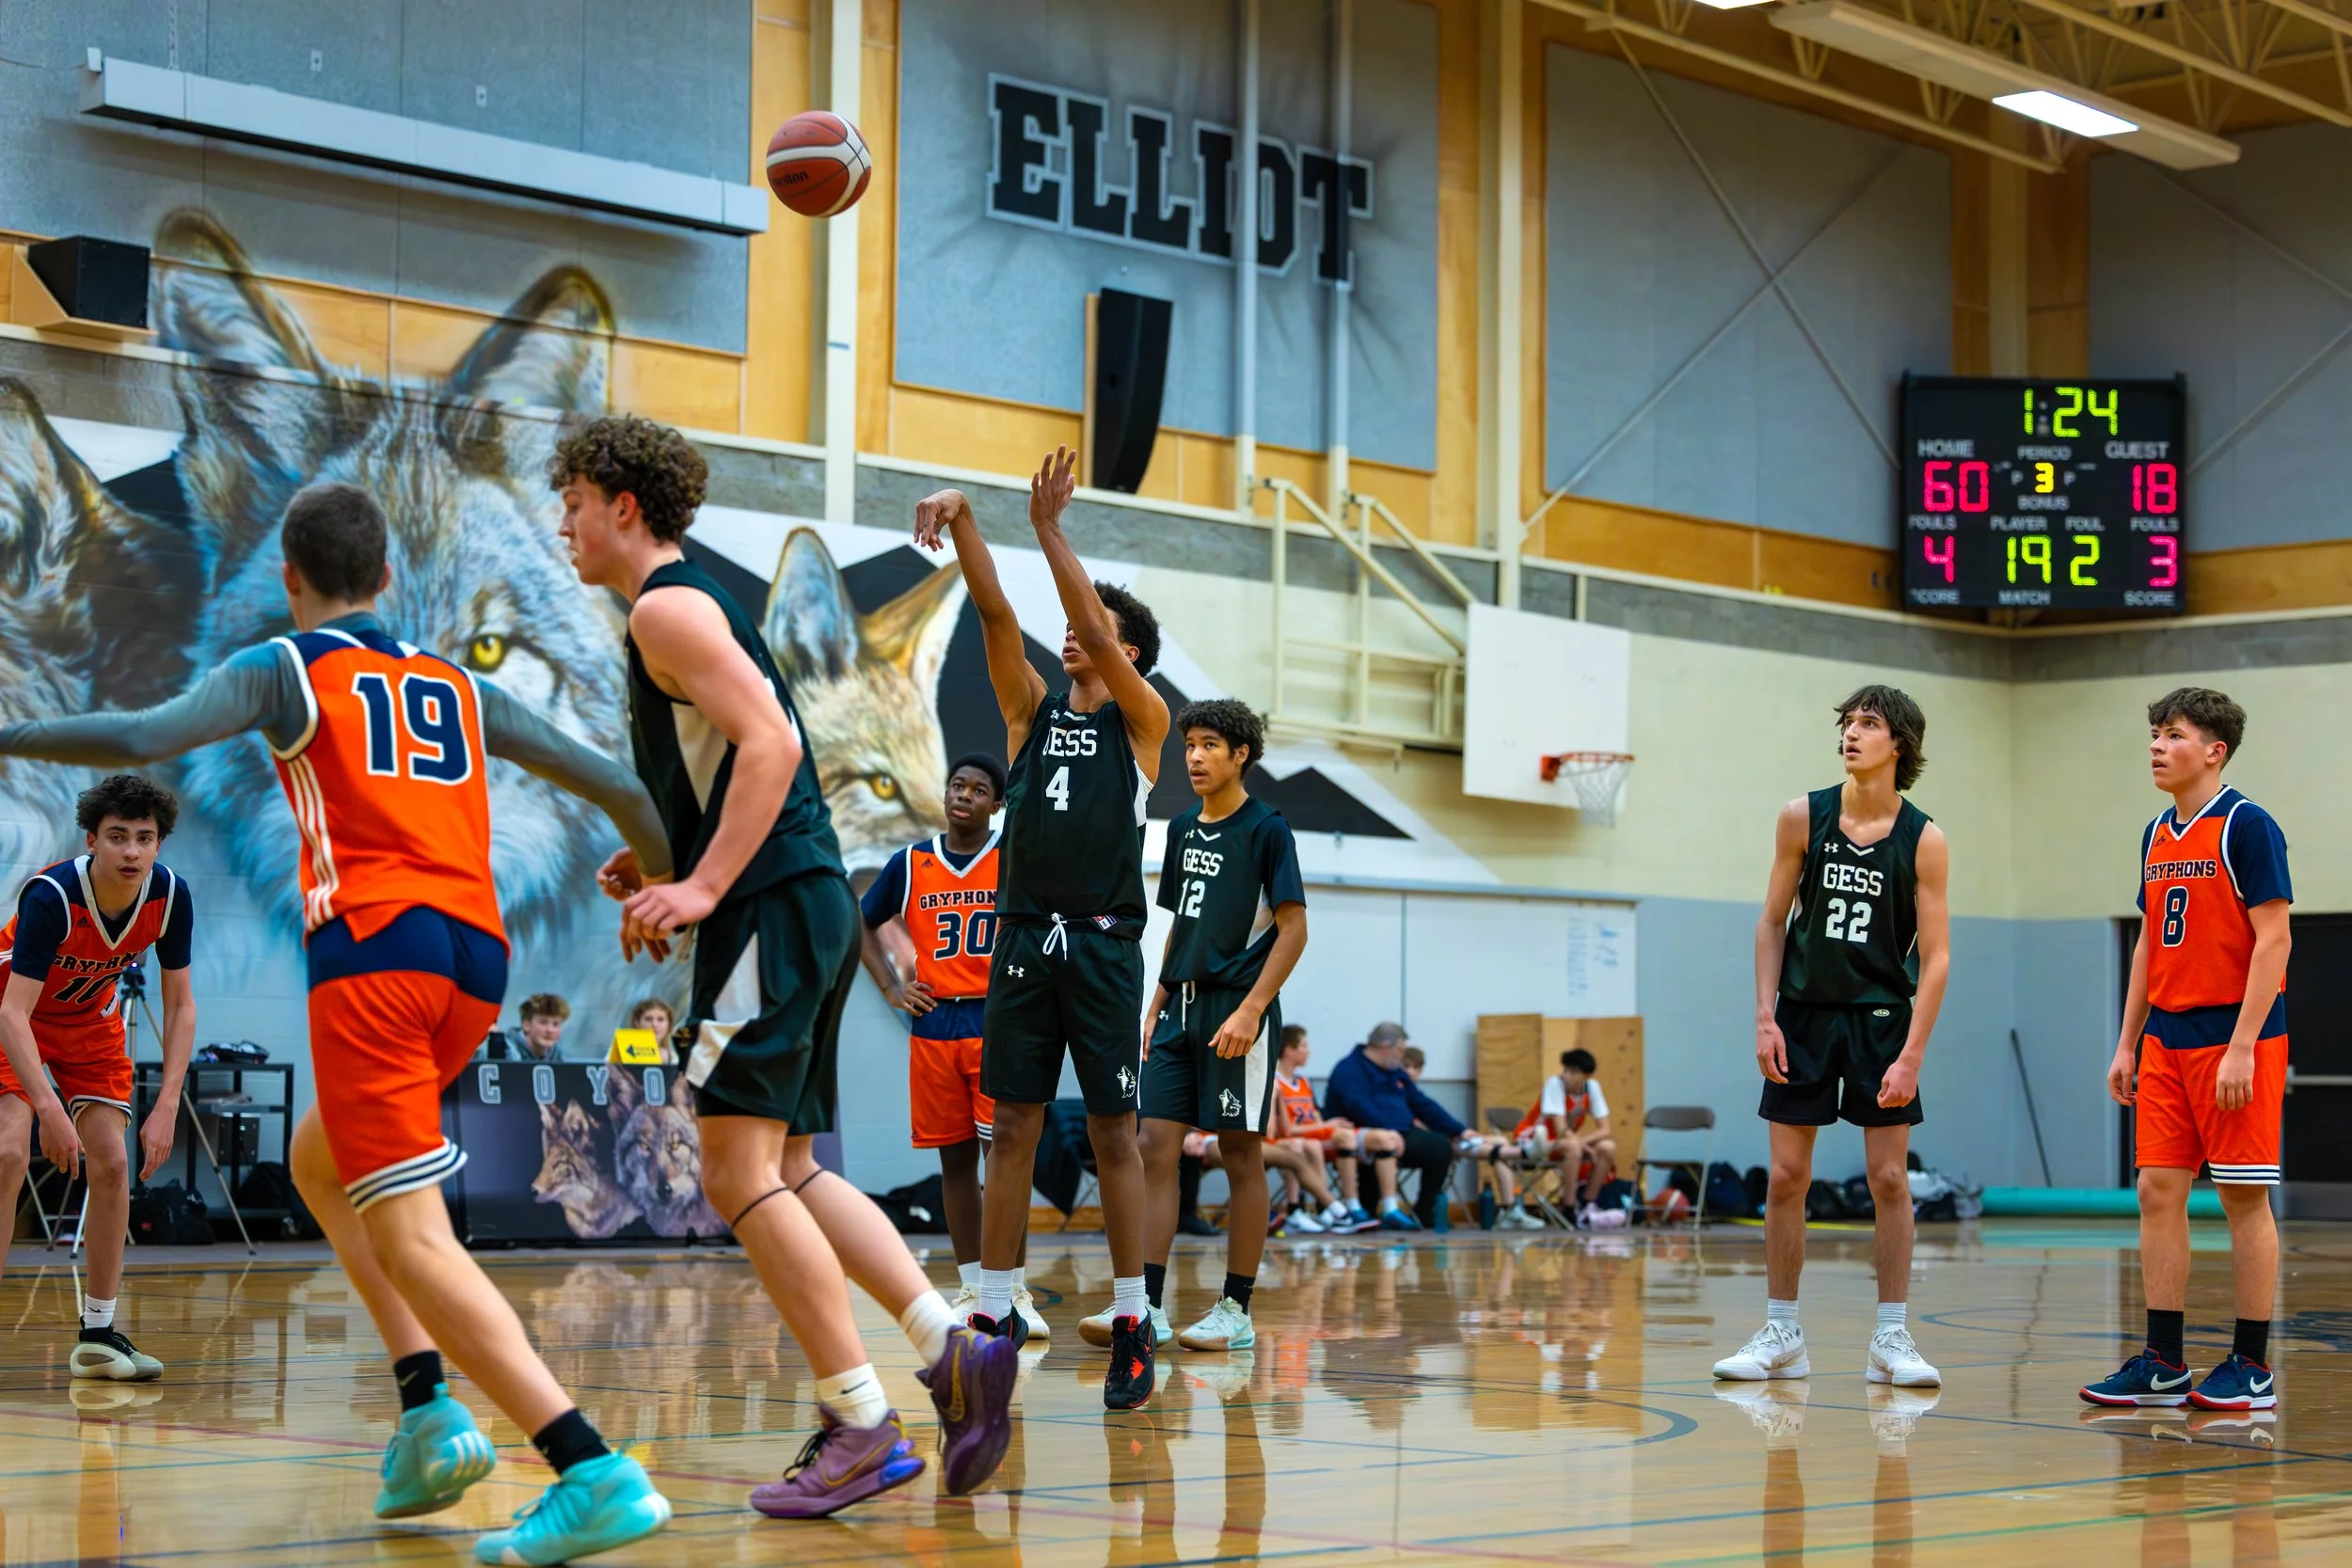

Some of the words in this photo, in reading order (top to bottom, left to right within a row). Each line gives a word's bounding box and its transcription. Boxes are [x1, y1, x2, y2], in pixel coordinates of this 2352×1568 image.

[986, 71, 1374, 288] ELLIOT
[2024, 387, 2119, 437] 1:24
[1917, 439, 1975, 458] HOME
[2017, 446, 2073, 461] PERIOD
[2105, 441, 2170, 459] GUEST
[1923, 461, 1990, 513] 60
[2034, 462, 2055, 494] 3
[2132, 464, 2177, 514] 18
[1908, 515, 1957, 530] FOULS
[1990, 515, 2048, 531] PLAYER
[2017, 496, 2070, 511] BONUS
[2130, 517, 2180, 532] FOULS
[1924, 535, 1955, 584] 4
[2007, 535, 2052, 584] 19
[2070, 535, 2101, 586] 2
[2149, 535, 2178, 587] 3
[1998, 591, 2051, 606] MATCH
[2123, 591, 2176, 606] SCORE
[351, 672, 472, 786] 19
[1045, 766, 1070, 811] 4
[1183, 848, 1224, 878] GESS
[1823, 863, 1883, 897] GESS
[2145, 859, 2217, 883] GRYPHONS
[1178, 878, 1206, 919] 12
[2162, 886, 2189, 947] 8
[934, 910, 998, 960] 30
[1825, 897, 1872, 943] 22
